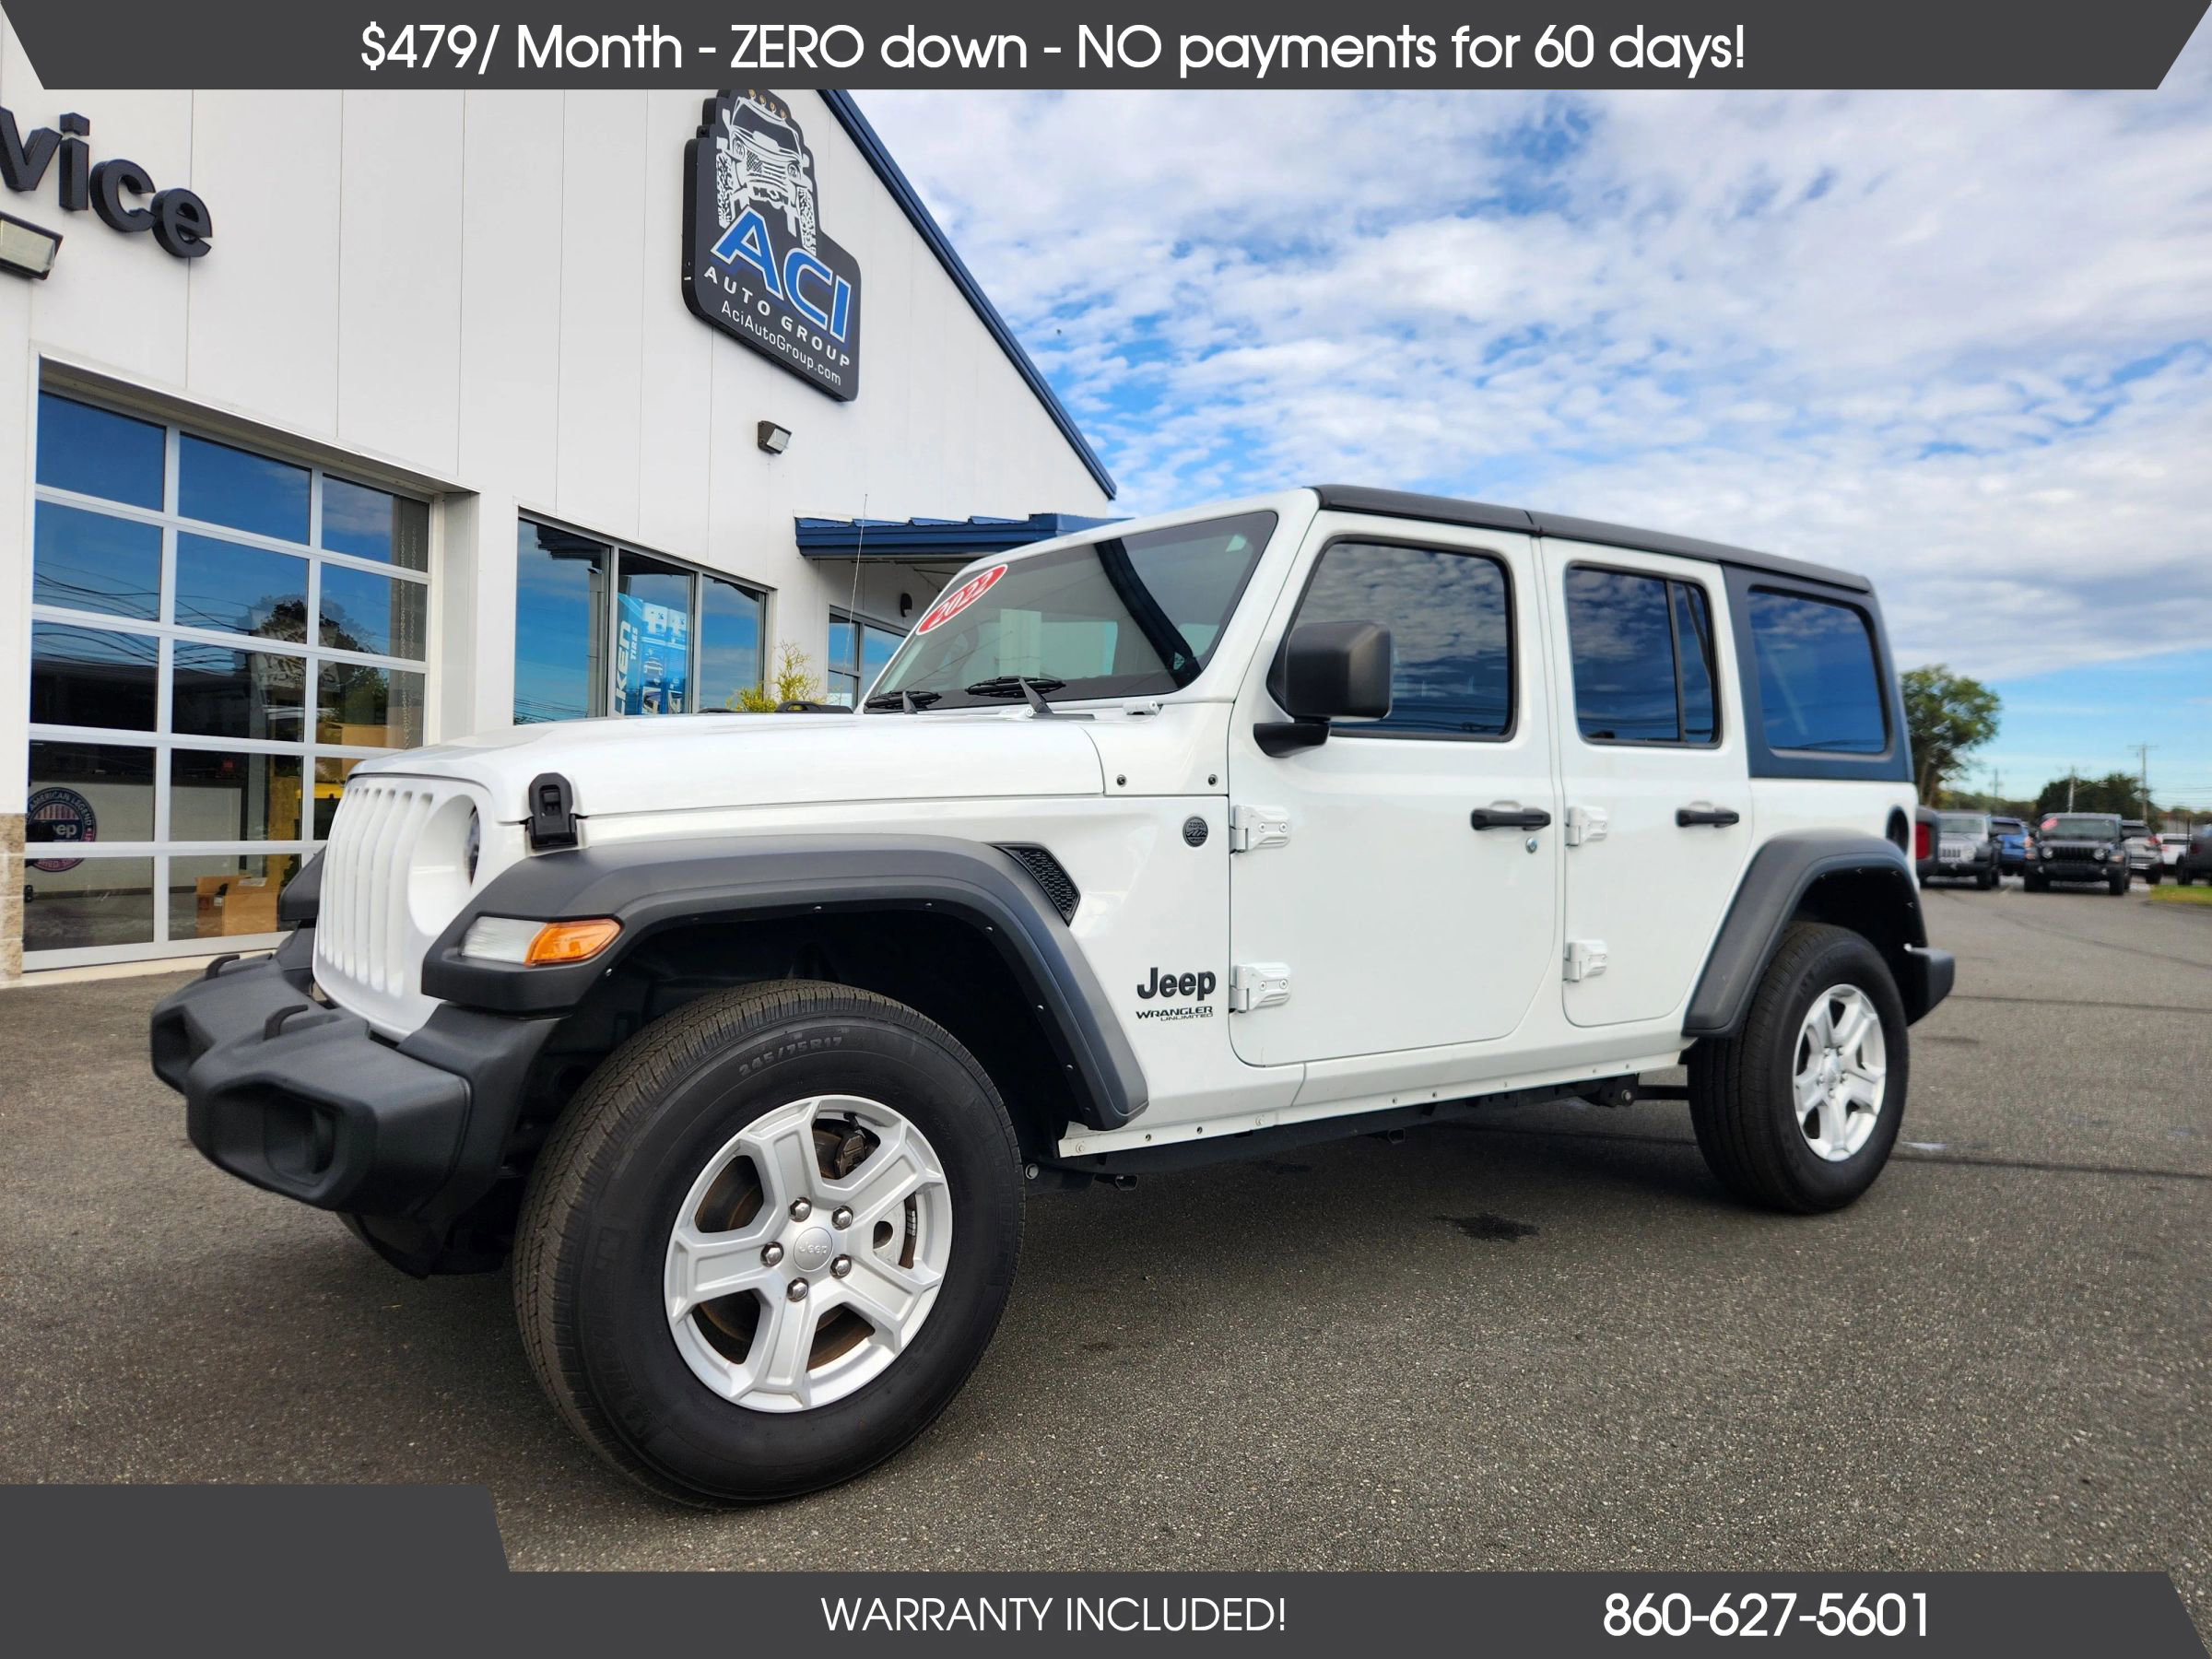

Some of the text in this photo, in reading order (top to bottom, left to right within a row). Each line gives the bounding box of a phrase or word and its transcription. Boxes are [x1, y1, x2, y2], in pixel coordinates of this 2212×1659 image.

[711, 205, 851, 343] ACI
[704, 265, 850, 368] AUTO GROUP
[722, 300, 841, 386] AciAutoGroup.com
[928, 571, 993, 629] 2022
[630, 626, 639, 660] TIRES
[1136, 967, 1217, 1002] Jeep
[1135, 1006, 1213, 1019] WRANGLER
[1160, 1012, 1214, 1021] UNLIMITED
